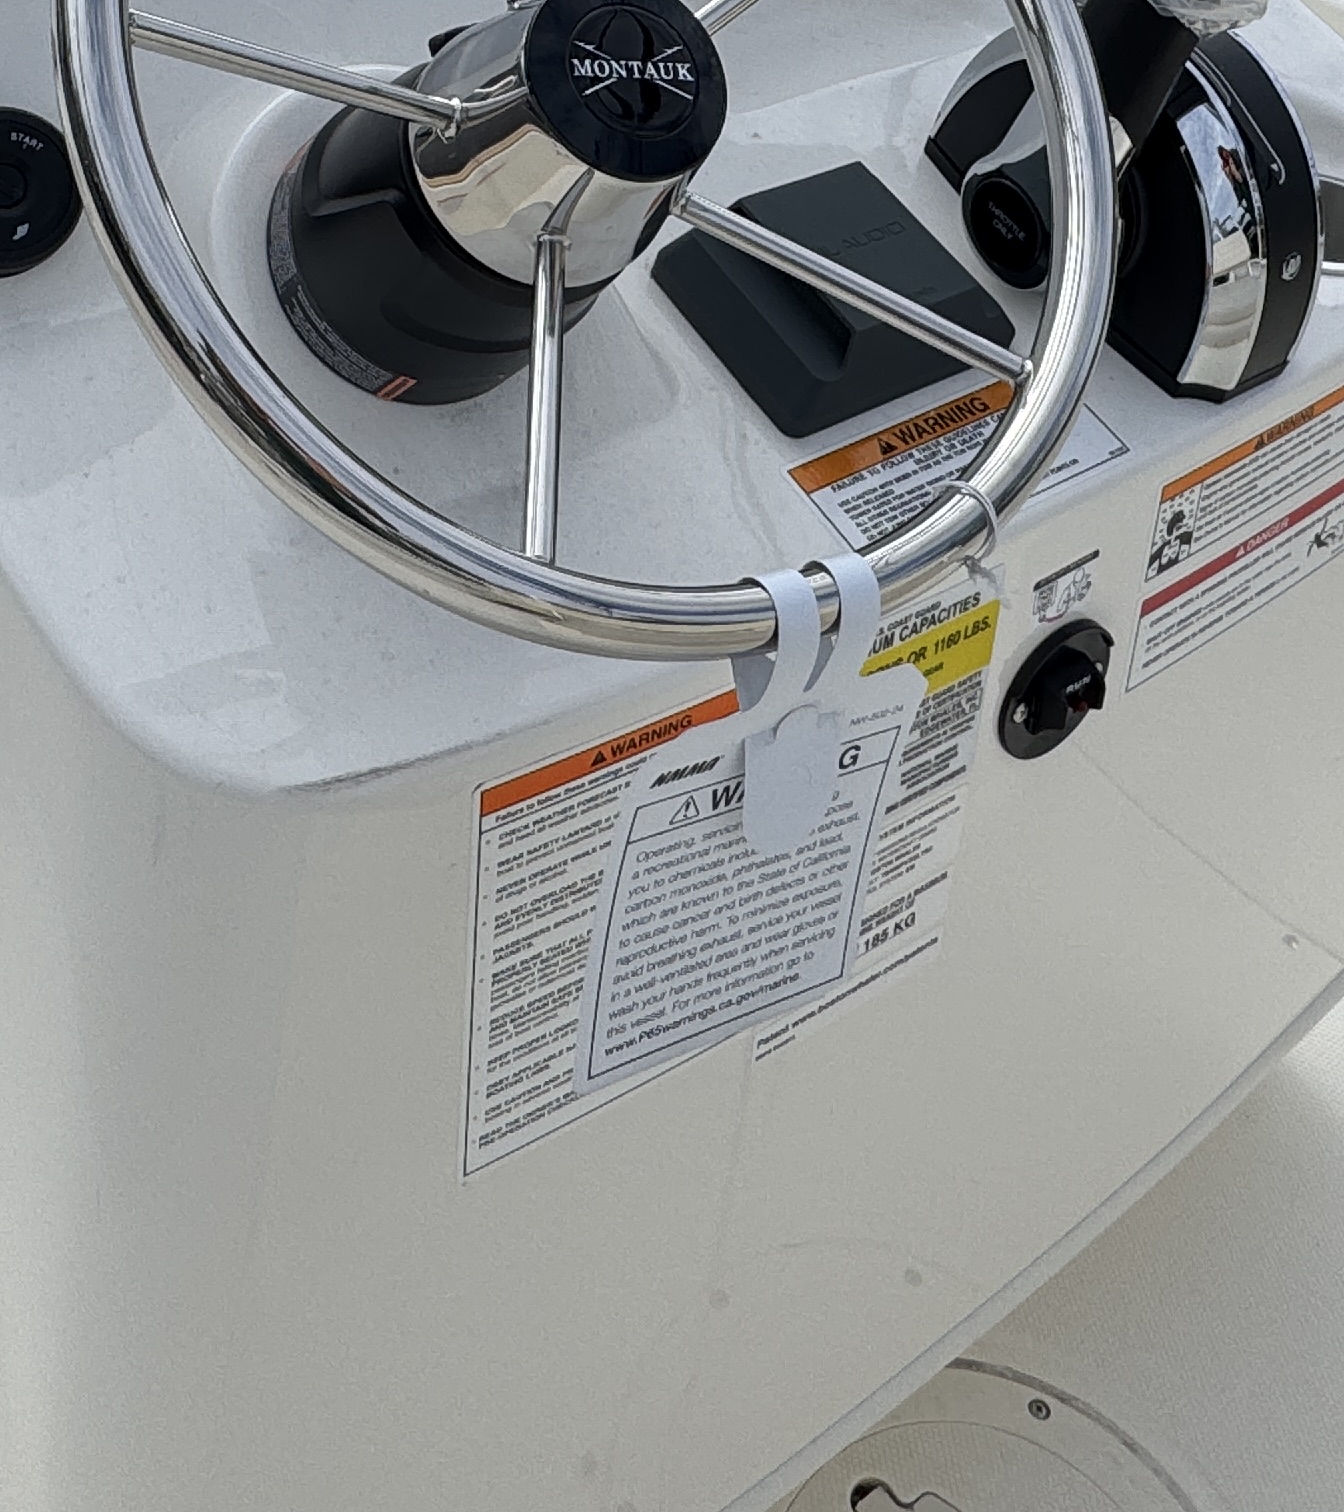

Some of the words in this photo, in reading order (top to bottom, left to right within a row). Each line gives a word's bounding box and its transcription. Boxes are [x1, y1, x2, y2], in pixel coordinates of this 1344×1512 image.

[570, 58, 695, 81] MONTAUK
[10, 132, 44, 151] START
[842, 220, 906, 249] AUDIO
[987, 201, 1026, 242] THROTTLE
[992, 219, 1014, 240] ONLY
[892, 396, 989, 445] WARNING
[898, 591, 982, 642] CAPACITIES
[906, 646, 928, 665] OR
[963, 615, 992, 641] LBS.
[609, 714, 694, 759] WARNING
[621, 911, 656, 931] which
[658, 904, 678, 919] are
[680, 890, 719, 911] known
[721, 885, 734, 897] to
[736, 878, 755, 891] the
[756, 867, 786, 884] State
[788, 860, 801, 873] of
[802, 844, 851, 868] California
[624, 893, 667, 914] carbon
[669, 872, 728, 898] monoxide,
[794, 839, 817, 856] and
[627, 882, 650, 899] you
[652, 877, 665, 889] to
[667, 857, 725, 883] chemicals
[727, 848, 756, 863] inclu
[630, 870, 640, 880] a
[642, 845, 711, 875] recreational
[618, 937, 630, 949] to
[633, 924, 670, 944] cause
[671, 908, 711, 930] cancer
[712, 898, 736, 915] and
[738, 890, 763, 907] birth
[765, 876, 805, 897] defects
[807, 872, 818, 881] or
[821, 860, 849, 876] other
[609, 991, 620, 1002] in
[714, 947, 738, 963] area
[740, 937, 762, 954] and
[764, 927, 791, 944] wear
[827, 910, 839, 921] or
[612, 964, 644, 985] avoid
[646, 946, 697, 972] breathing
[747, 914, 783, 935] service
[785, 905, 808, 923] your
[810, 892, 842, 911] vessel
[615, 934, 687, 966] reproductive
[690, 922, 721, 939] harm.
[726, 914, 739, 927] To
[741, 897, 790, 920] minimize
[606, 1023, 627, 1039] this
[671, 997, 691, 1012] For
[692, 986, 722, 1005] more
[724, 961, 783, 992] information
[786, 955, 801, 970] go
[803, 950, 815, 961] to
[608, 1000, 639, 1021] wash
[640, 990, 667, 1010] your
[668, 977, 703, 996] hands
[706, 957, 757, 982] frequently
[759, 944, 789, 961] when
[790, 926, 835, 950] servicing
